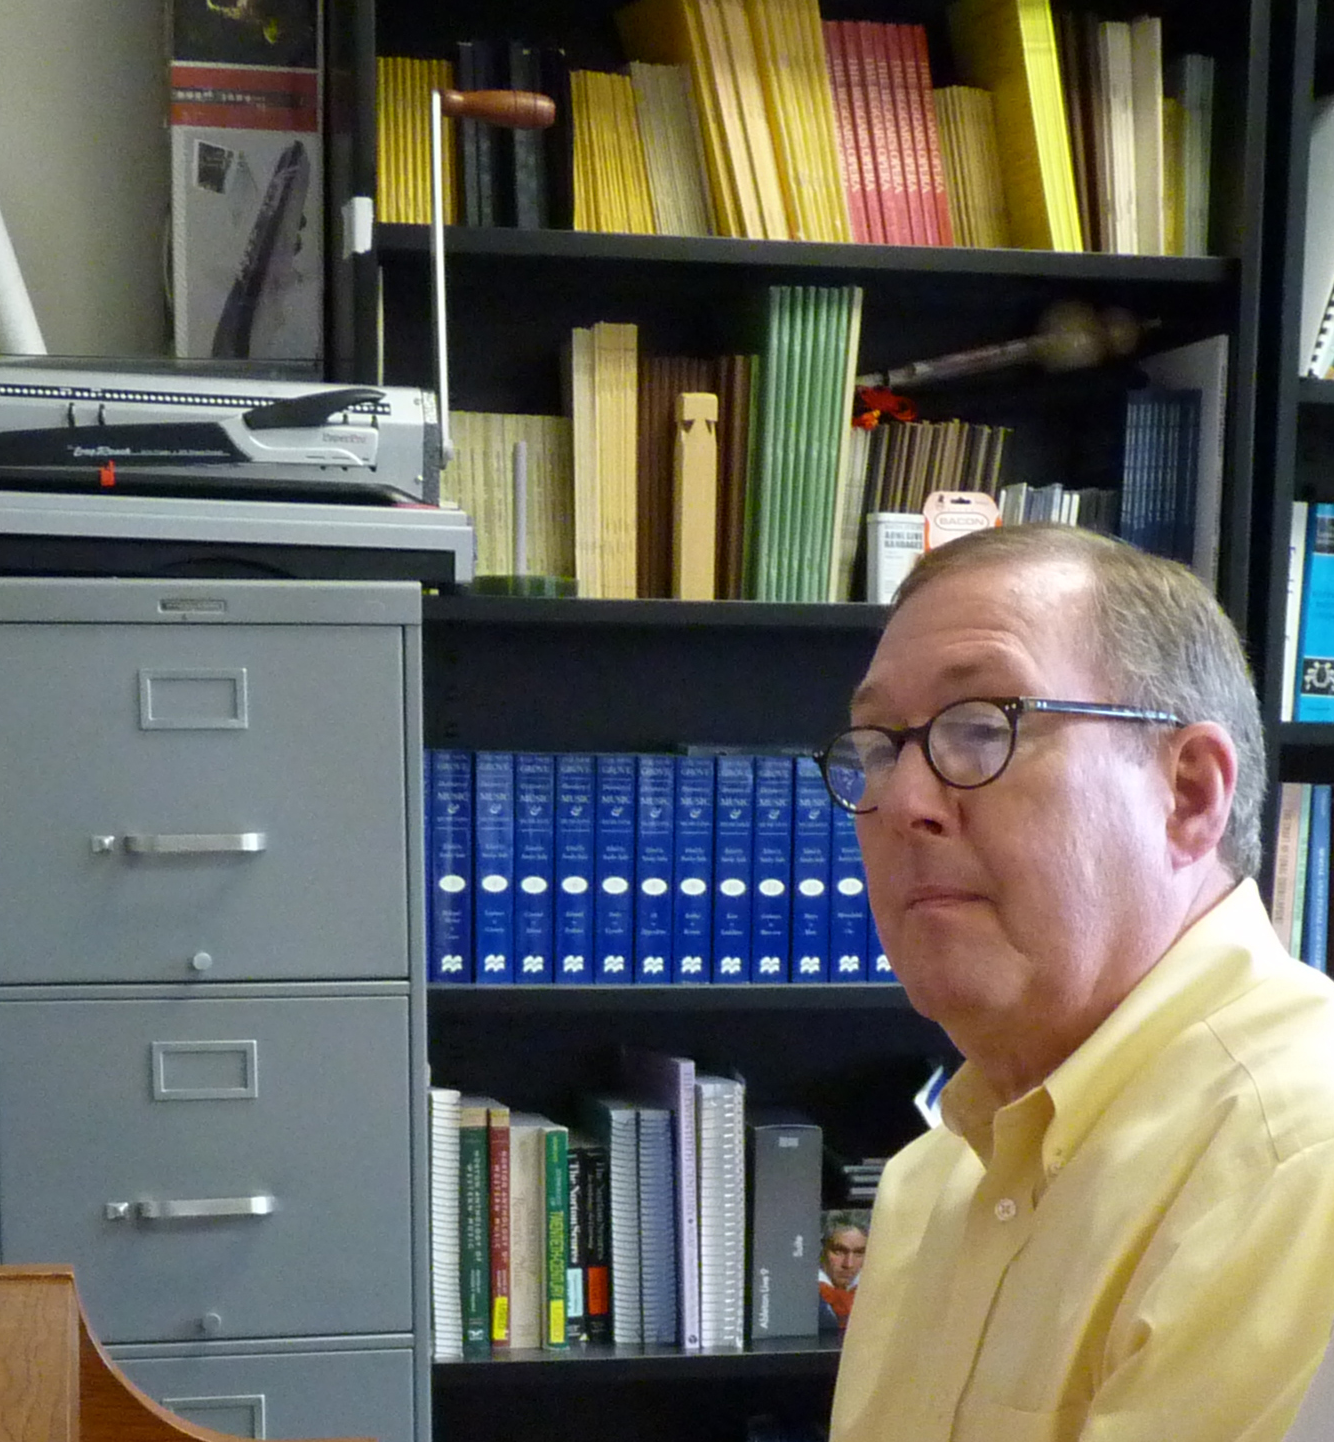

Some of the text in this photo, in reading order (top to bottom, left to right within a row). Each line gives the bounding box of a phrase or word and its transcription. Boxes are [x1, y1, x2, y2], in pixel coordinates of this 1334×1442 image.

[939, 517, 984, 526] BACON
[569, 1185, 580, 1225] Norton
[760, 1267, 770, 1329] Ableton Live 9
